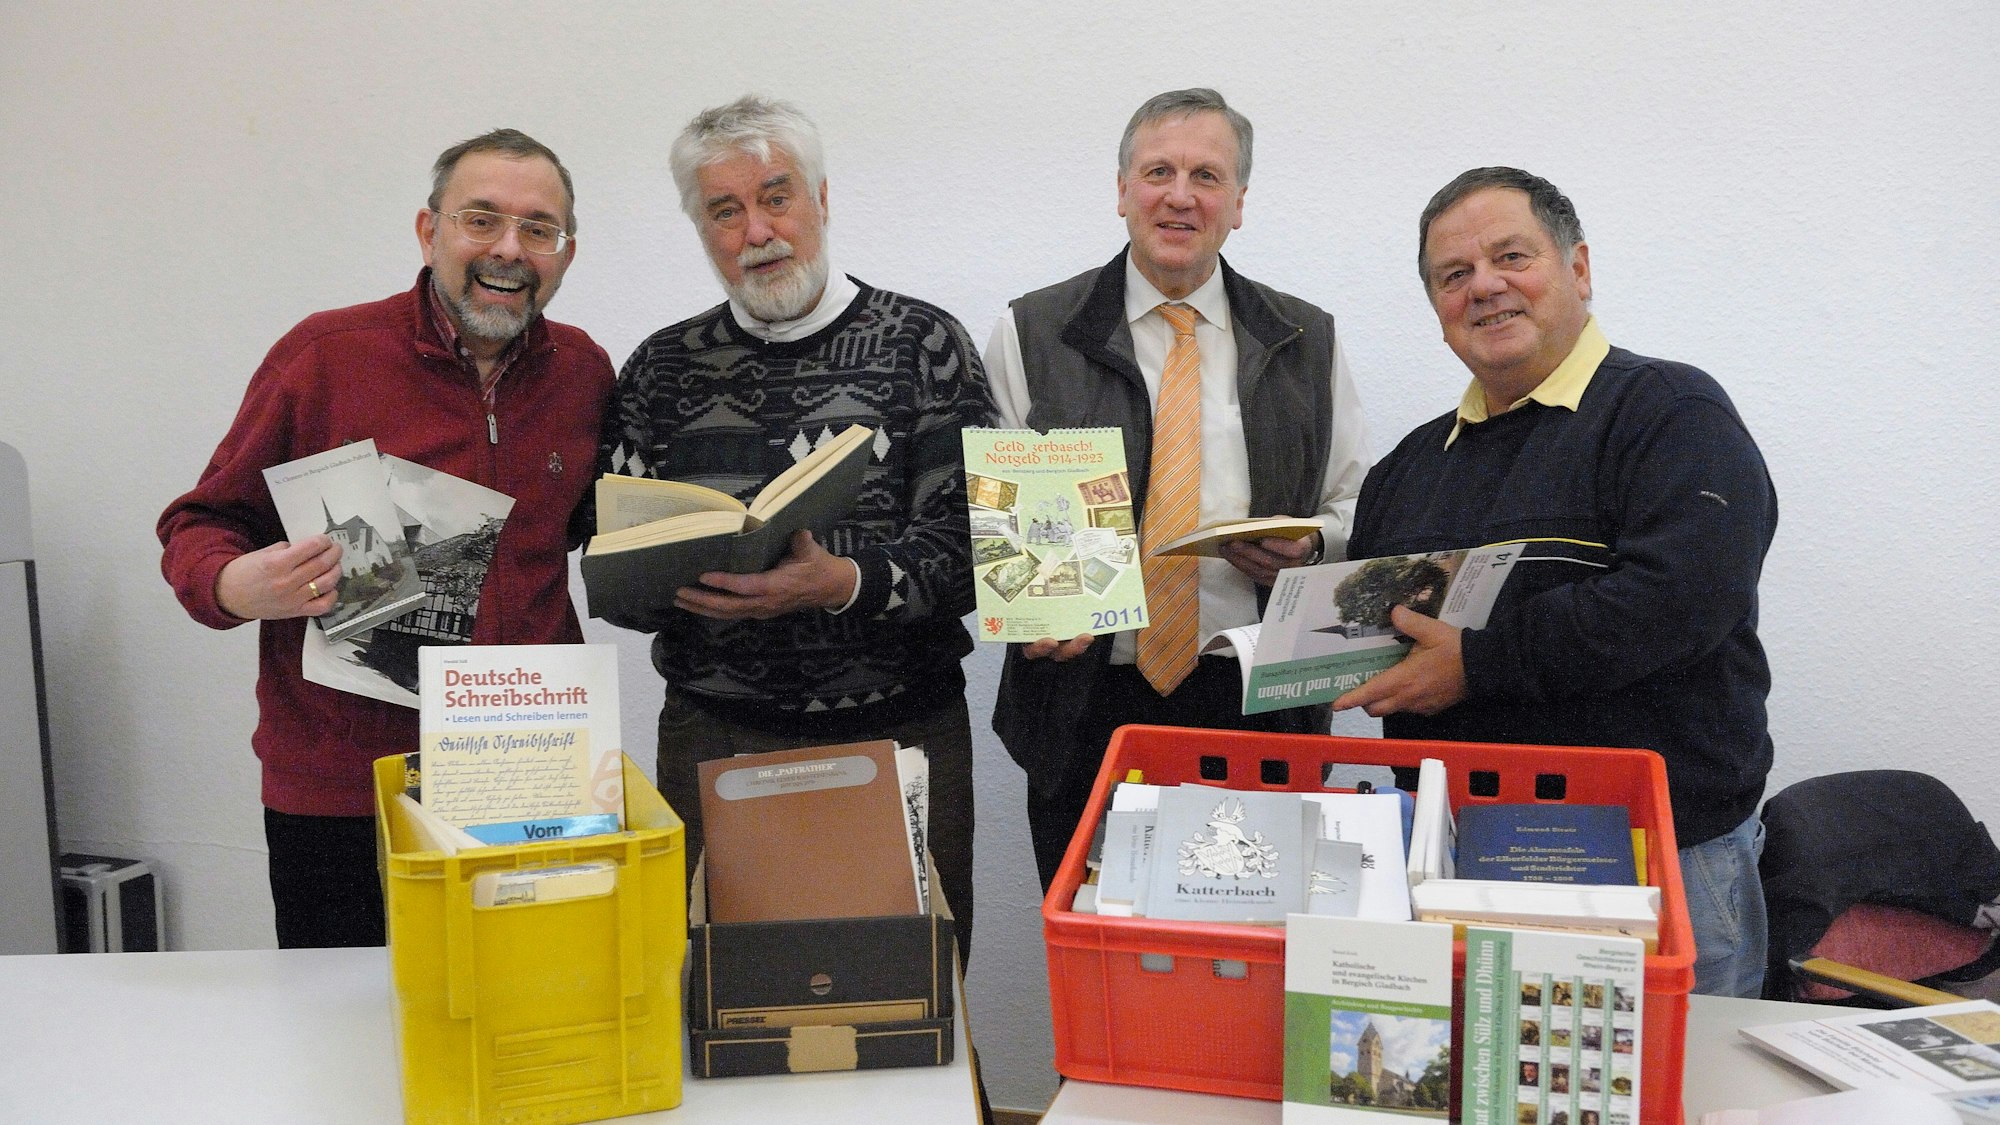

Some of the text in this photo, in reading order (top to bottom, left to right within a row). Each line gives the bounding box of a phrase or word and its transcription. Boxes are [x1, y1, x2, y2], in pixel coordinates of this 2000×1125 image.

[994, 441, 1024, 453] Geld
[985, 452, 1040, 467] Notgeld
[1491, 552, 1512, 568] 14
[1091, 606, 1142, 629] 2011
[445, 667, 542, 687] Deutsche
[1332, 672, 1363, 689] Sülz
[1257, 681, 1303, 700] Dhünn
[1306, 677, 1329, 694] und
[445, 687, 588, 708] Schreibschrift
[453, 712, 588, 723] Lesen und Schreiben lernen
[758, 770, 773, 778] DIE
[523, 824, 564, 839] Vom
[1550, 856, 1619, 864] Bürgermeister
[1176, 882, 1276, 897] Katterbach
[1332, 960, 1375, 971] Katholische
[1475, 940, 1495, 984] Dhünn
[1342, 978, 1373, 988] Bergisch
[1375, 982, 1411, 991] Gladbach
[1349, 971, 1396, 982] evangelische
[1398, 975, 1427, 984] Kirchen
[1476, 987, 1492, 1014] und
[1474, 1017, 1491, 1044] Sülz
[1472, 1048, 1491, 1106] zwischen
